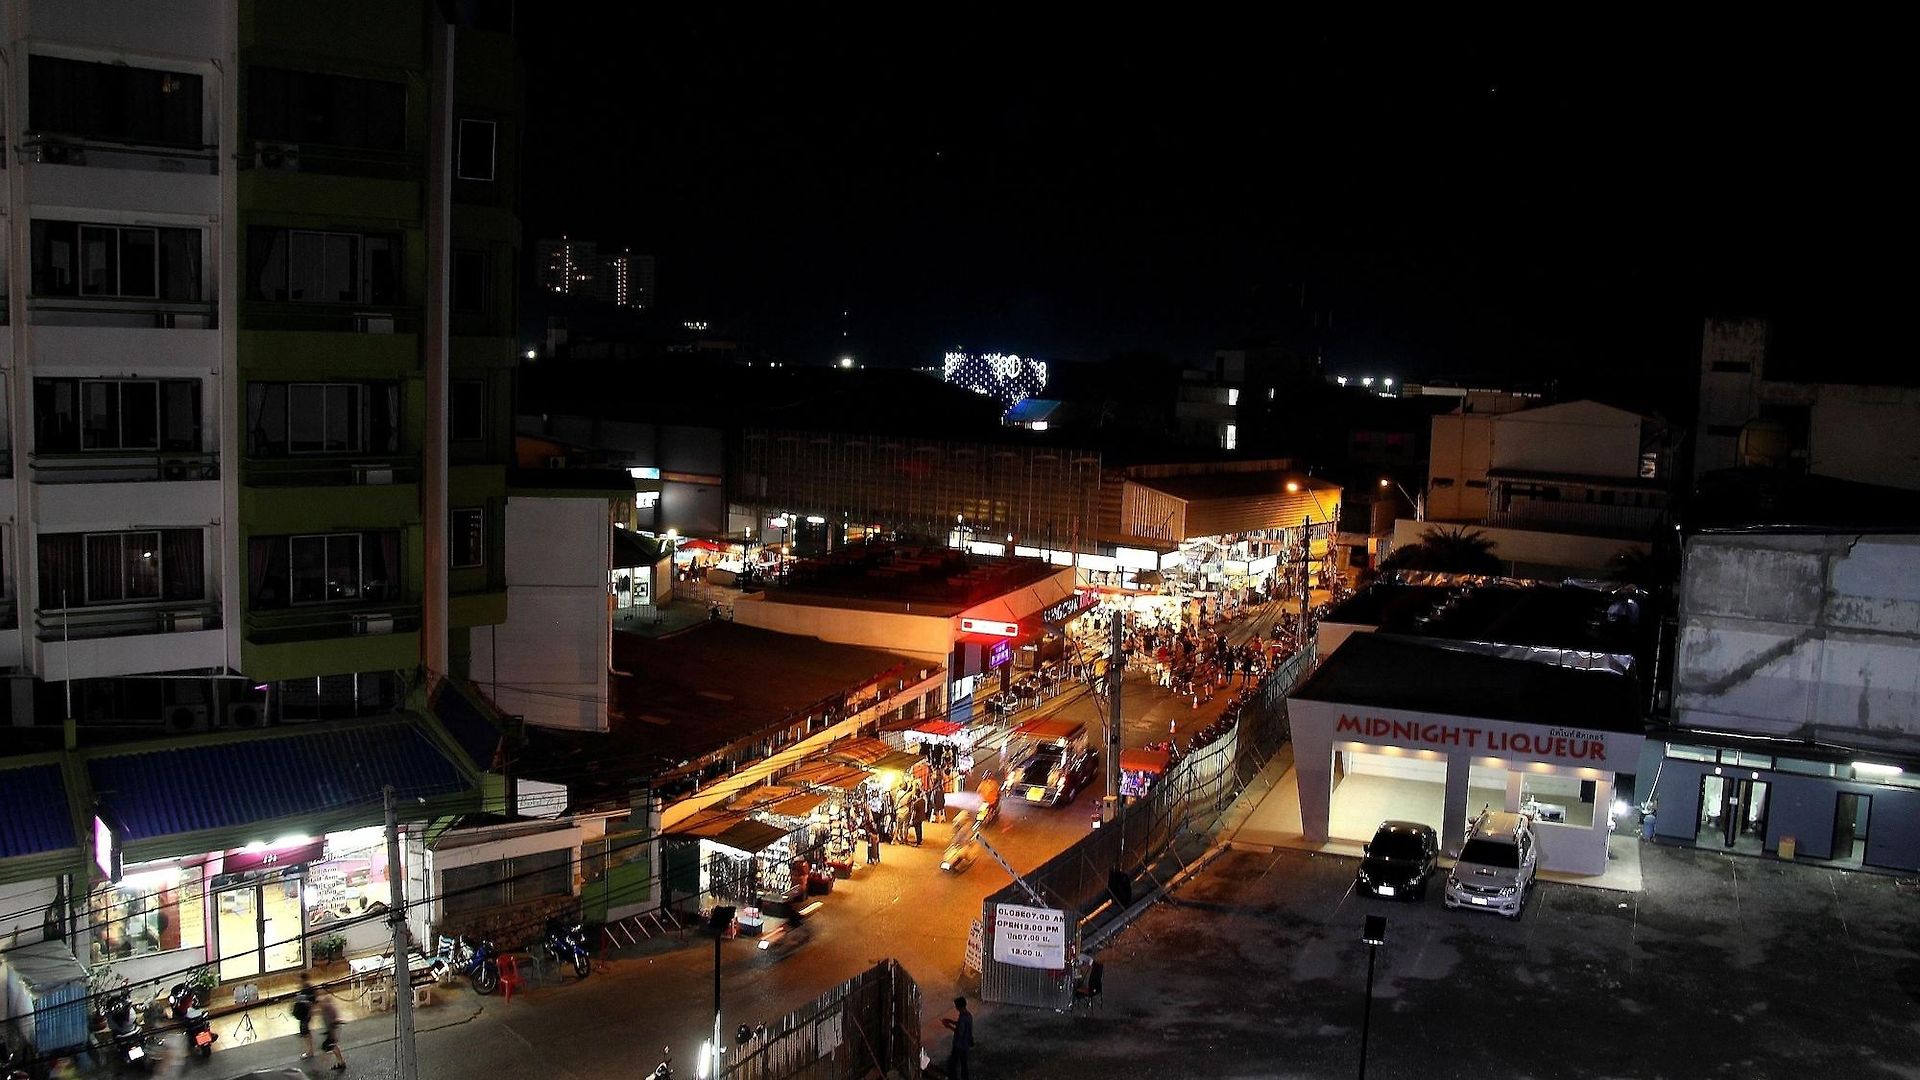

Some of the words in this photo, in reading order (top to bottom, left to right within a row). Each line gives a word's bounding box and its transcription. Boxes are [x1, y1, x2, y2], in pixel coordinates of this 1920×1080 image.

[1336, 713, 1482, 748] MIDNIGHT
[1488, 731, 1606, 760] LIQUEUR
[1046, 925, 1060, 933] PM
